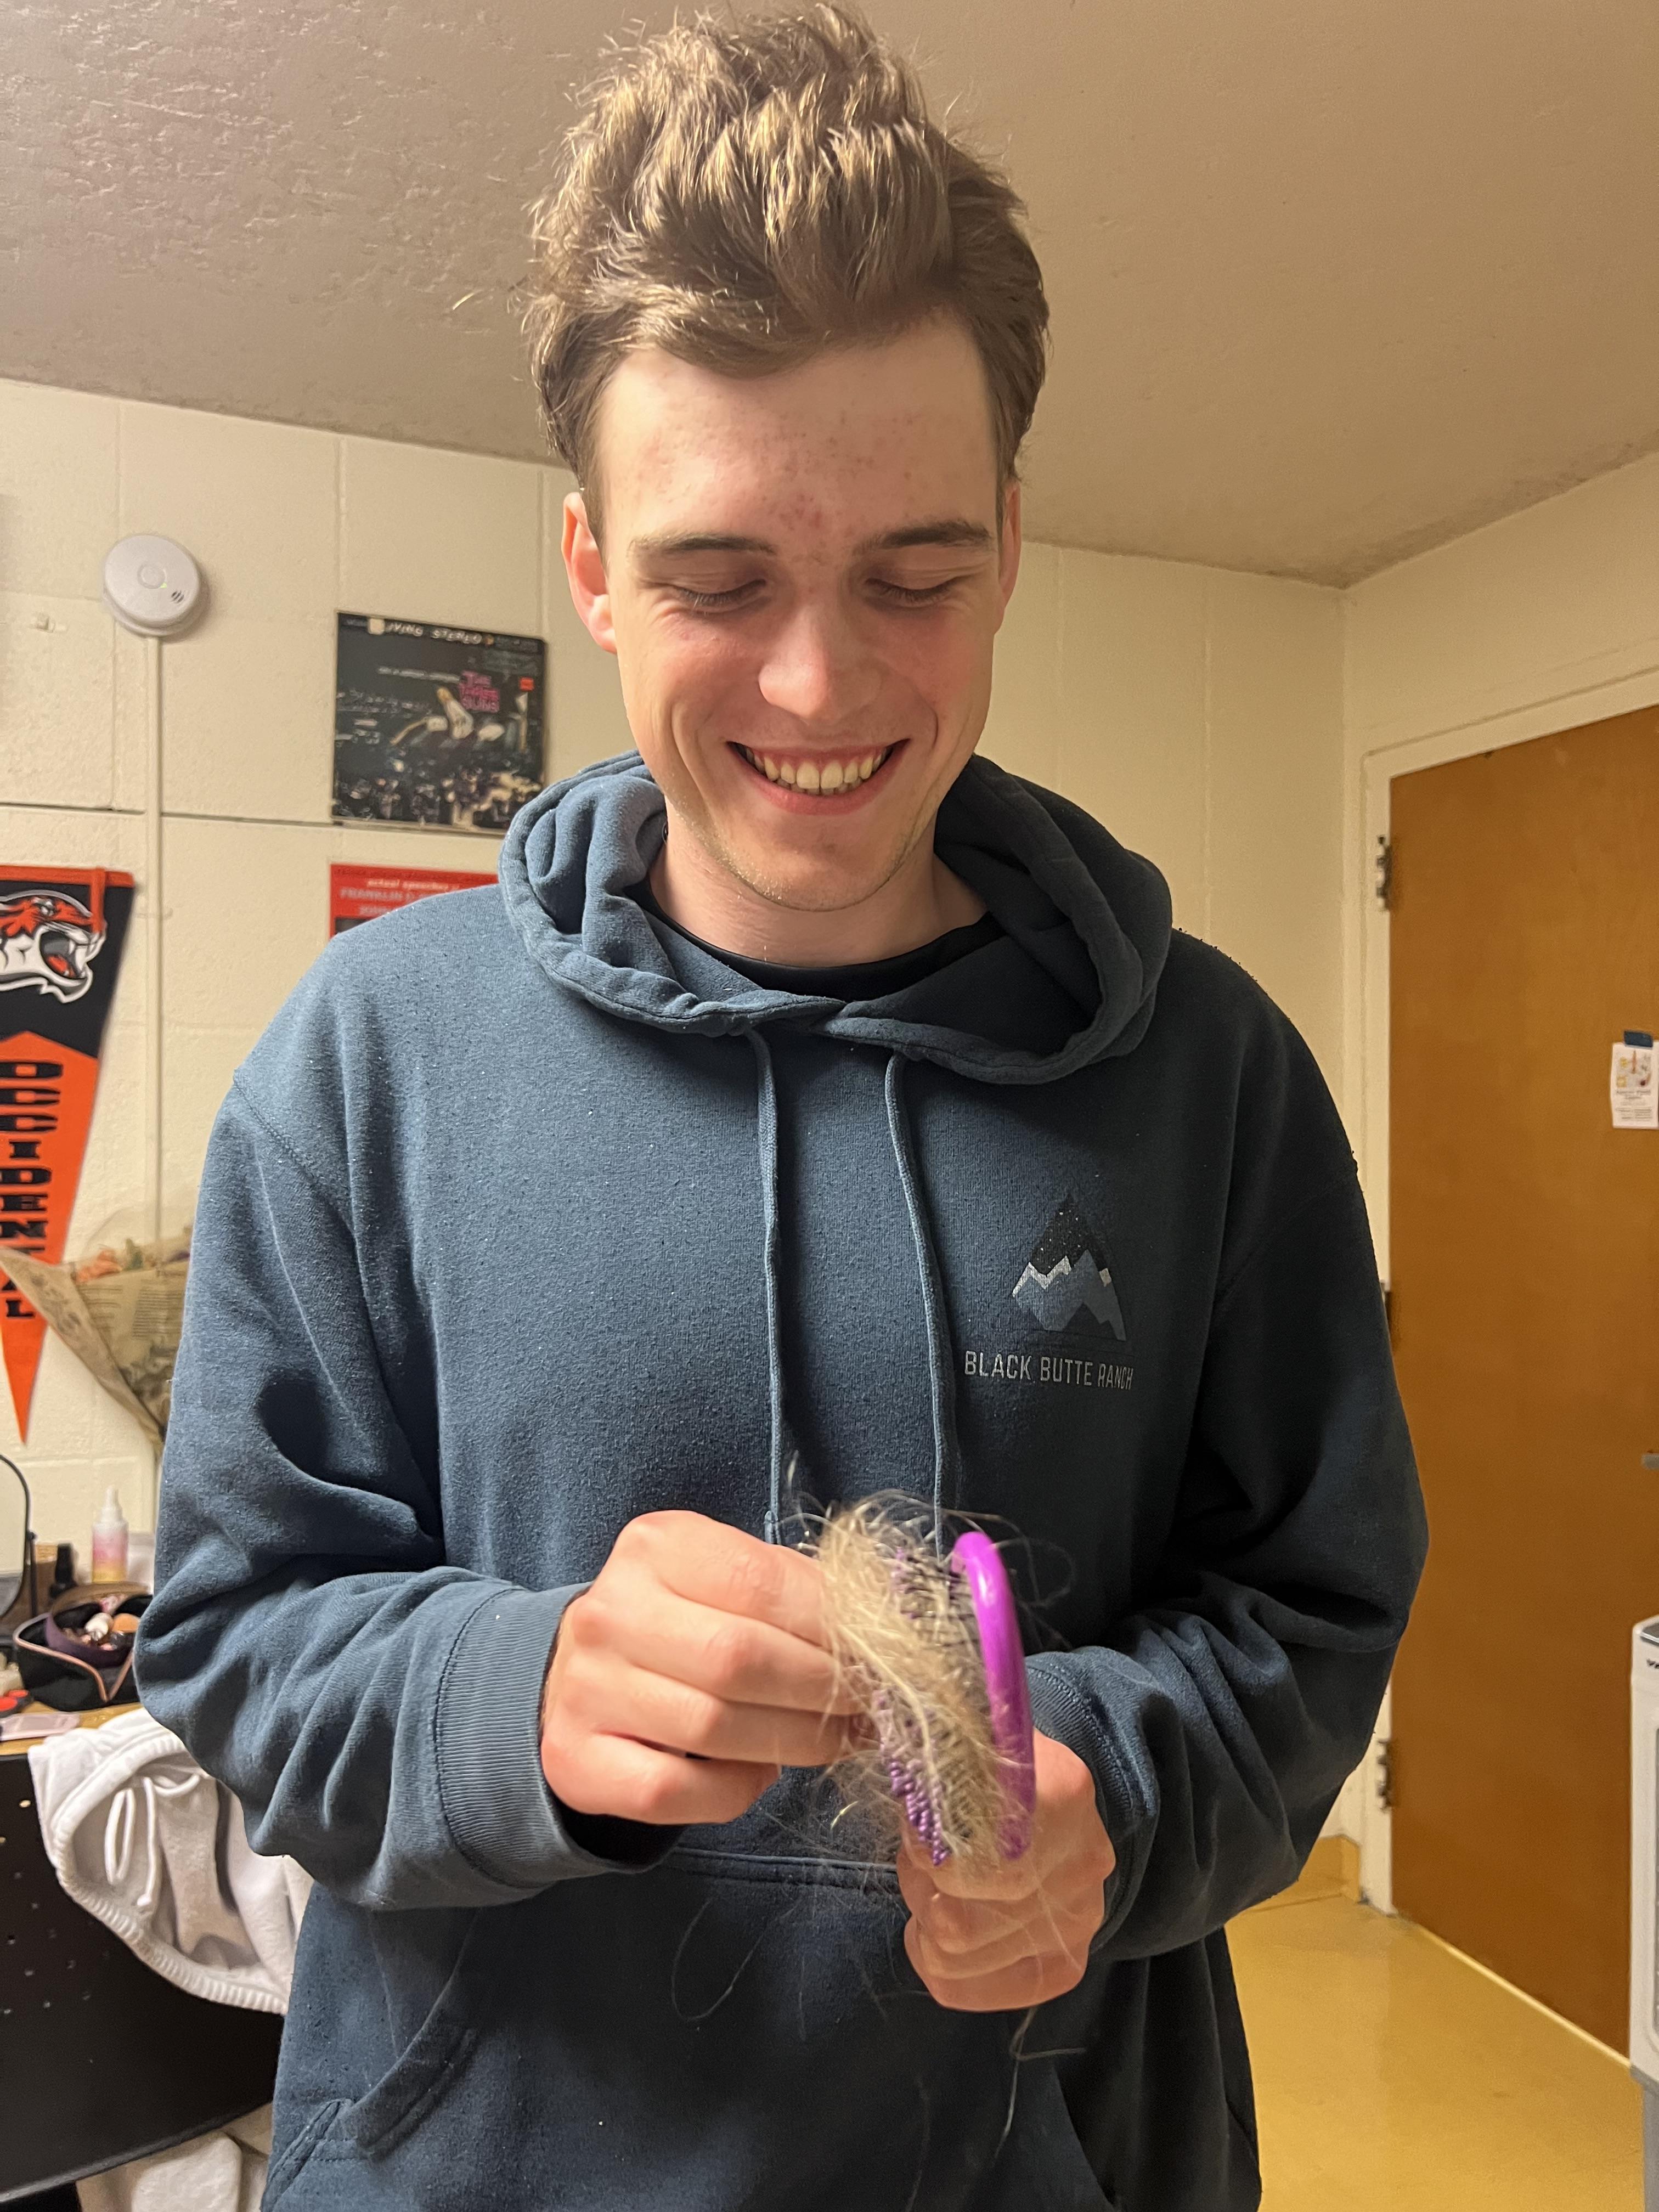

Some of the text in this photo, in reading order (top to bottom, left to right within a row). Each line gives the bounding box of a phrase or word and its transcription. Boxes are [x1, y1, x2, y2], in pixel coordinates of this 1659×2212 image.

[0, 1061, 63, 1318] OCCIDENL
[964, 1351, 1133, 1390] BLACK BUTTE RANCH
